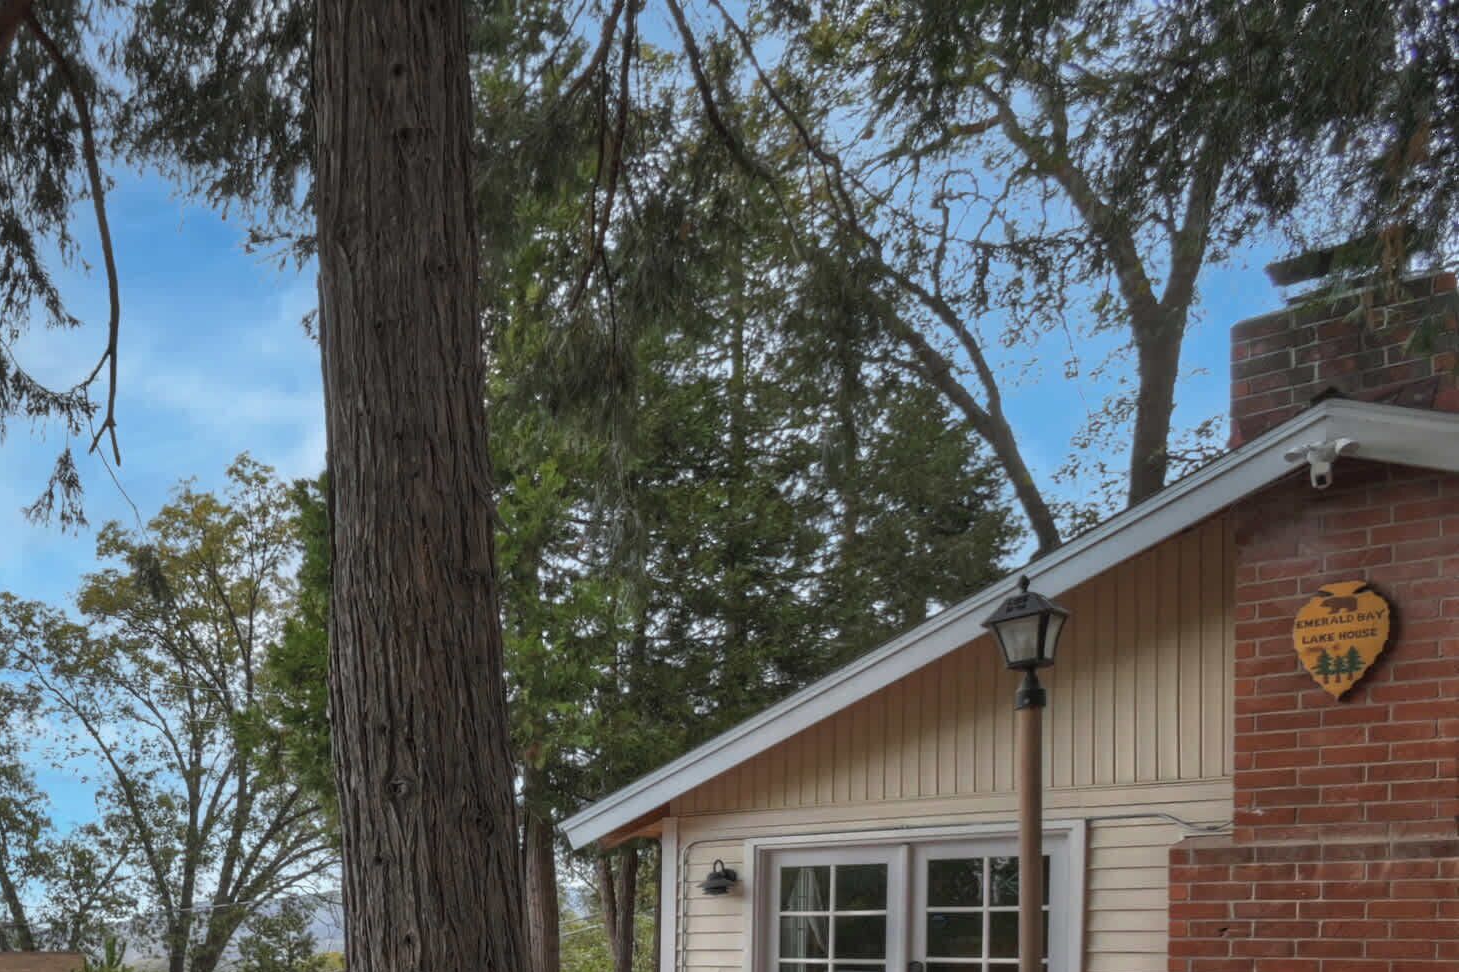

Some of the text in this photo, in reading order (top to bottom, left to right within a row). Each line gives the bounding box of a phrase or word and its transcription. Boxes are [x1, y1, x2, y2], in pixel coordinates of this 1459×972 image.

[1296, 608, 1385, 629] EMERALD BAY
[1302, 628, 1378, 644] LAKE HOUSE
